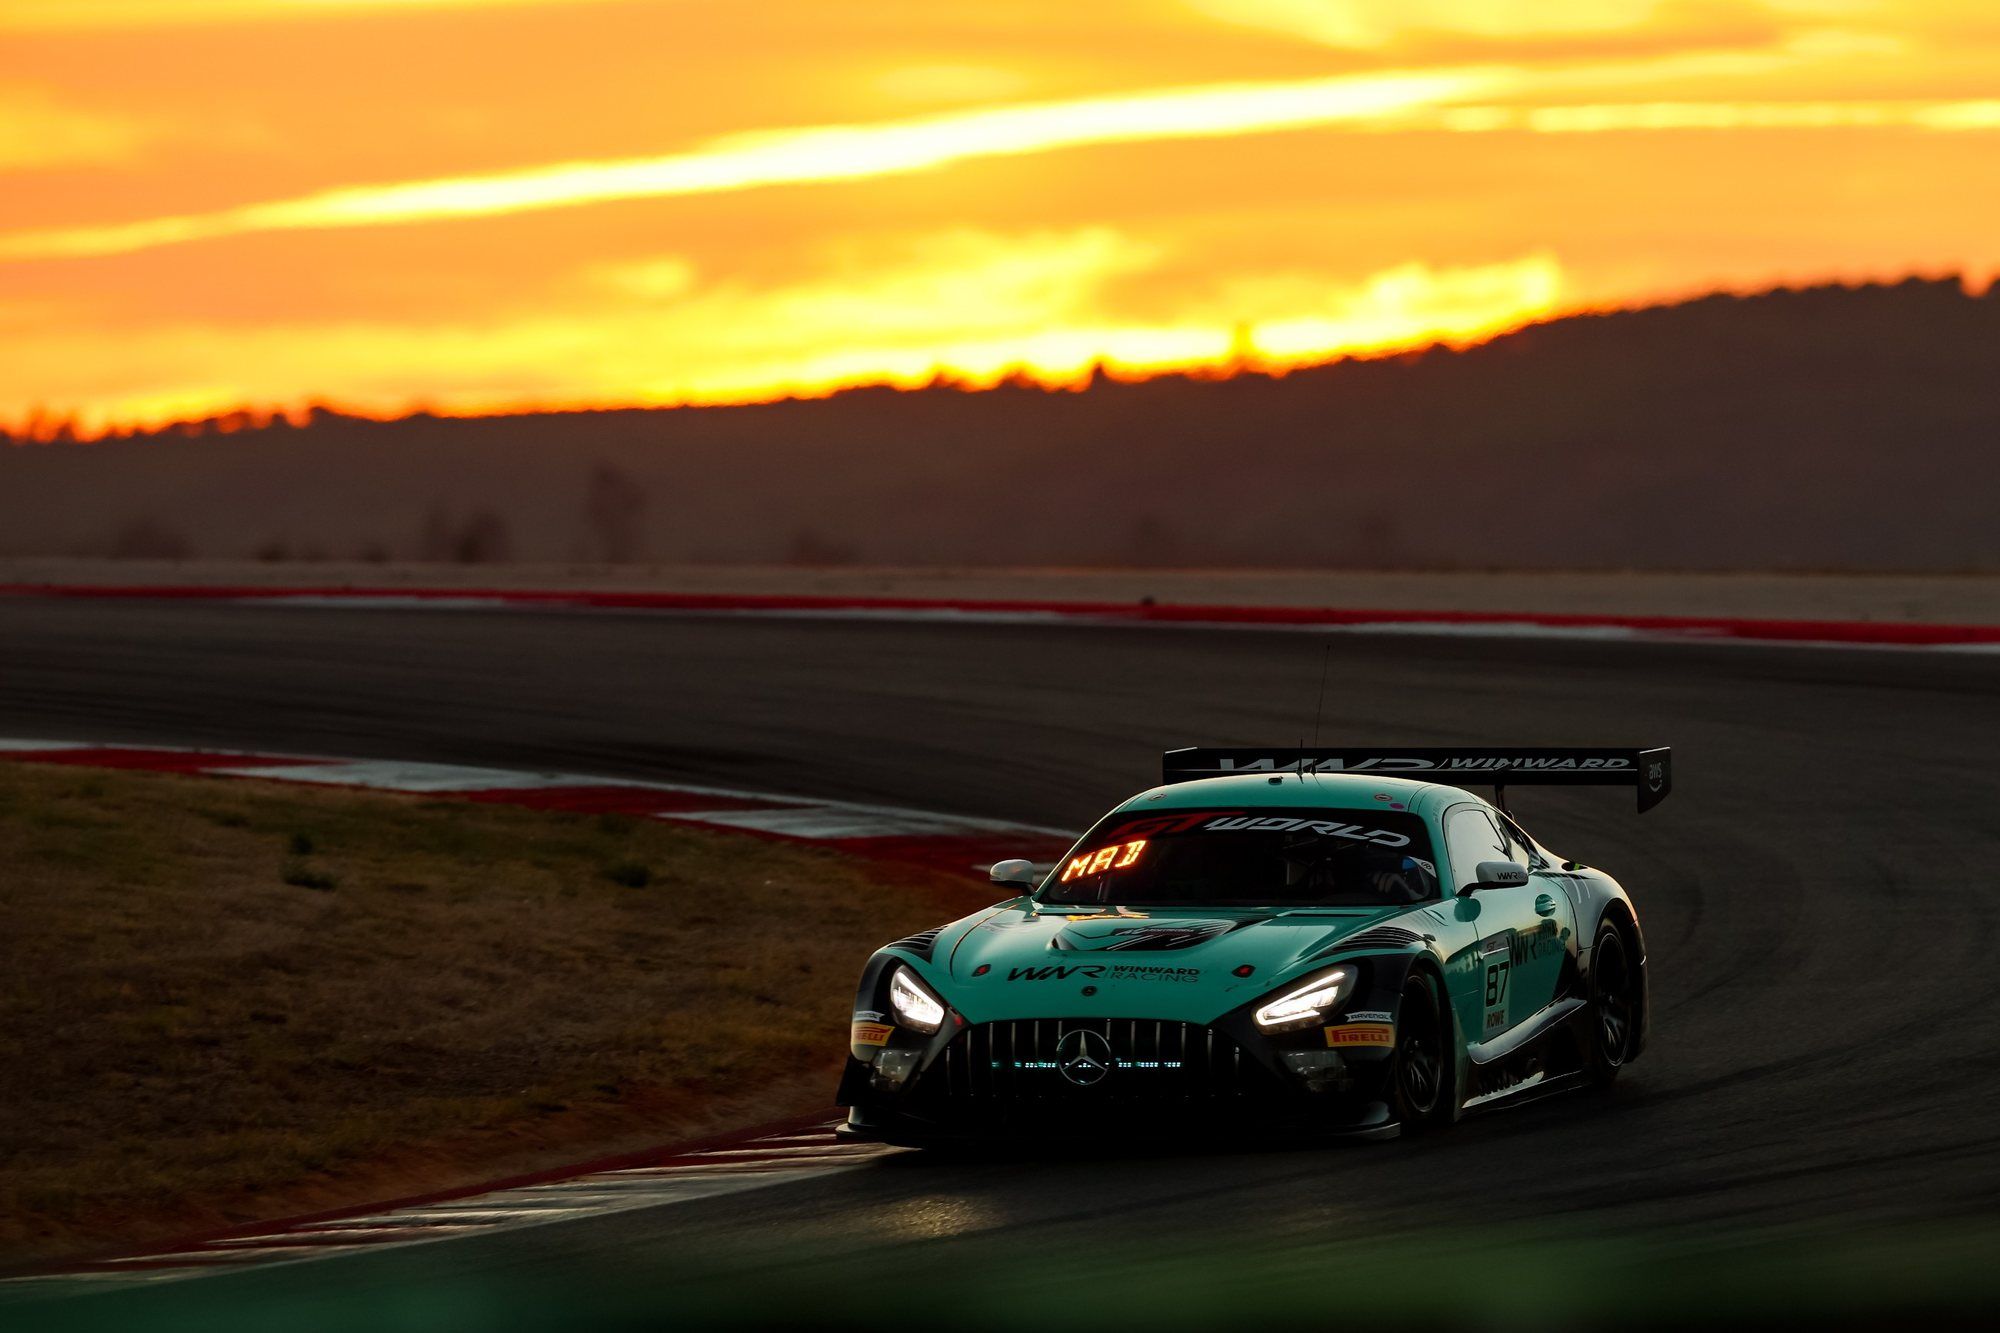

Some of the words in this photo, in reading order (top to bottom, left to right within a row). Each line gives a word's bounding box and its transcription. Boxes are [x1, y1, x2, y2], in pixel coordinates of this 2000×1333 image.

[1451, 757, 1630, 769] WINWARD
[1203, 817, 1411, 847] WORLD
[1109, 972, 1199, 983] RACING
[1113, 965, 1199, 976] WINWARD
[1486, 960, 1510, 1008] 87
[1486, 1008, 1505, 1029] ROWE
[1332, 1027, 1390, 1043] PIRELLI
